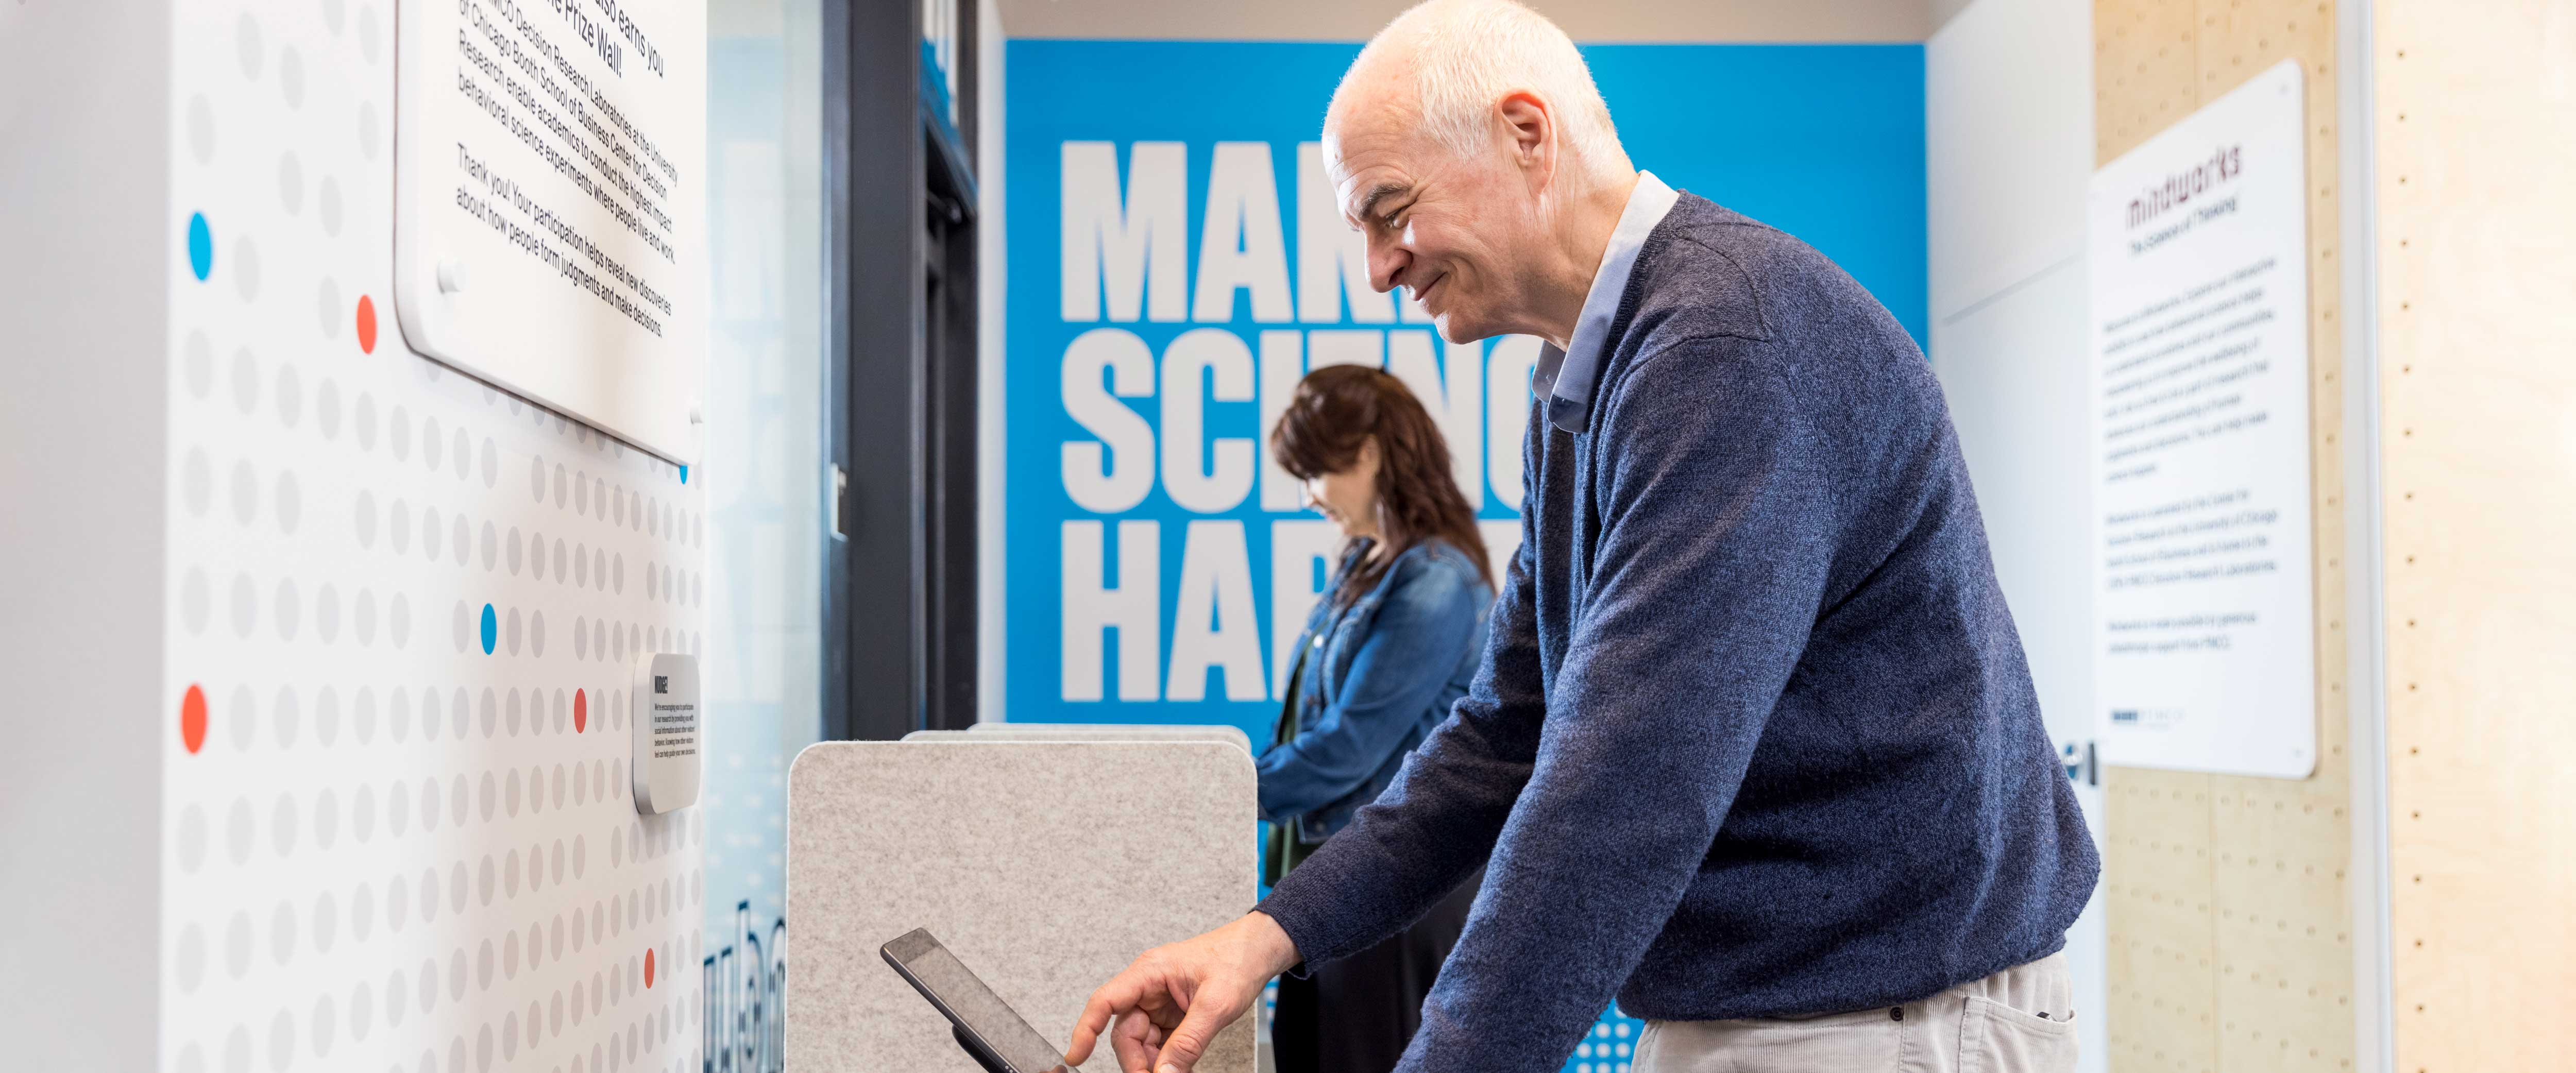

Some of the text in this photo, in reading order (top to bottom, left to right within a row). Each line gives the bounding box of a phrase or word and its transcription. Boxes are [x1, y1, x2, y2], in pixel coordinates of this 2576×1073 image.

[472, 3, 511, 58] Chicago
[513, 40, 538, 83] Booth
[540, 66, 567, 110] School
[569, 97, 577, 118] of
[578, 100, 609, 148] Business
[611, 132, 632, 168] Center
[633, 154, 642, 178] for
[642, 162, 667, 201] Decision
[516, 7, 552, 62] Decision
[554, 44, 589, 98] Research
[590, 80, 632, 139] Laboratories
[633, 128, 639, 147] at
[640, 132, 650, 157] the
[650, 141, 678, 188] University
[565, 0, 621, 79] Prize Wall!
[595, 0, 663, 79] so earns you
[459, 28, 672, 234] Research enable academics to conduct the highest impact
[459, 67, 675, 265] behavioral science experiments where people live and work.
[456, 185, 662, 338] about how people form judgments and make decisions.
[457, 142, 671, 316] Thank you! Your participation helps reveal new discoveries
[1060, 141, 1435, 323] MAK
